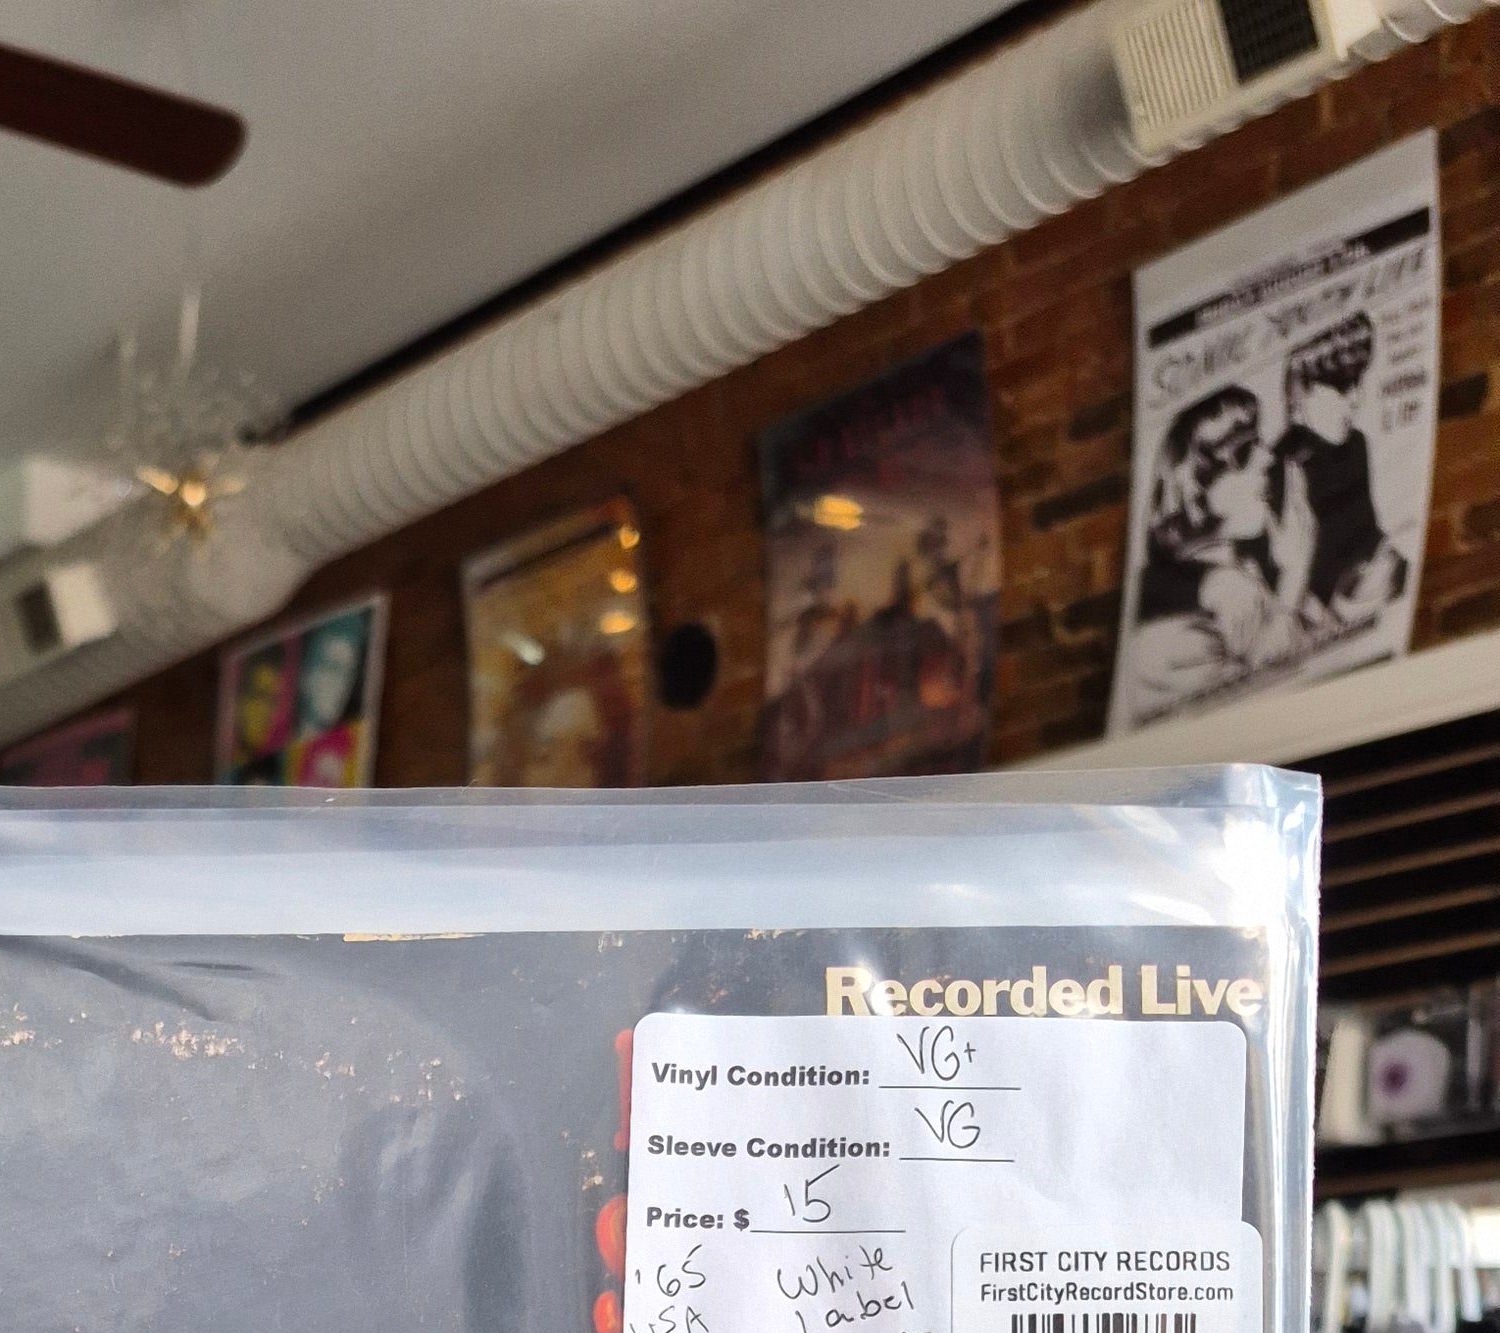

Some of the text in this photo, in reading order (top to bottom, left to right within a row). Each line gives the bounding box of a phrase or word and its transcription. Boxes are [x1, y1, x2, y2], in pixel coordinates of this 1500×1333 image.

[825, 964, 1263, 1017] Recorded Live
[651, 1025, 977, 1091] Vinyl Condition: VG+
[647, 1100, 981, 1158] Sleeve Condition: VG
[646, 1164, 841, 1232] Price: $ 15
[776, 1245, 893, 1300] White
[980, 1251, 1231, 1273] FIRST CITY RECORDS
[980, 1282, 1234, 1305] FirstCityRecordStore.com
